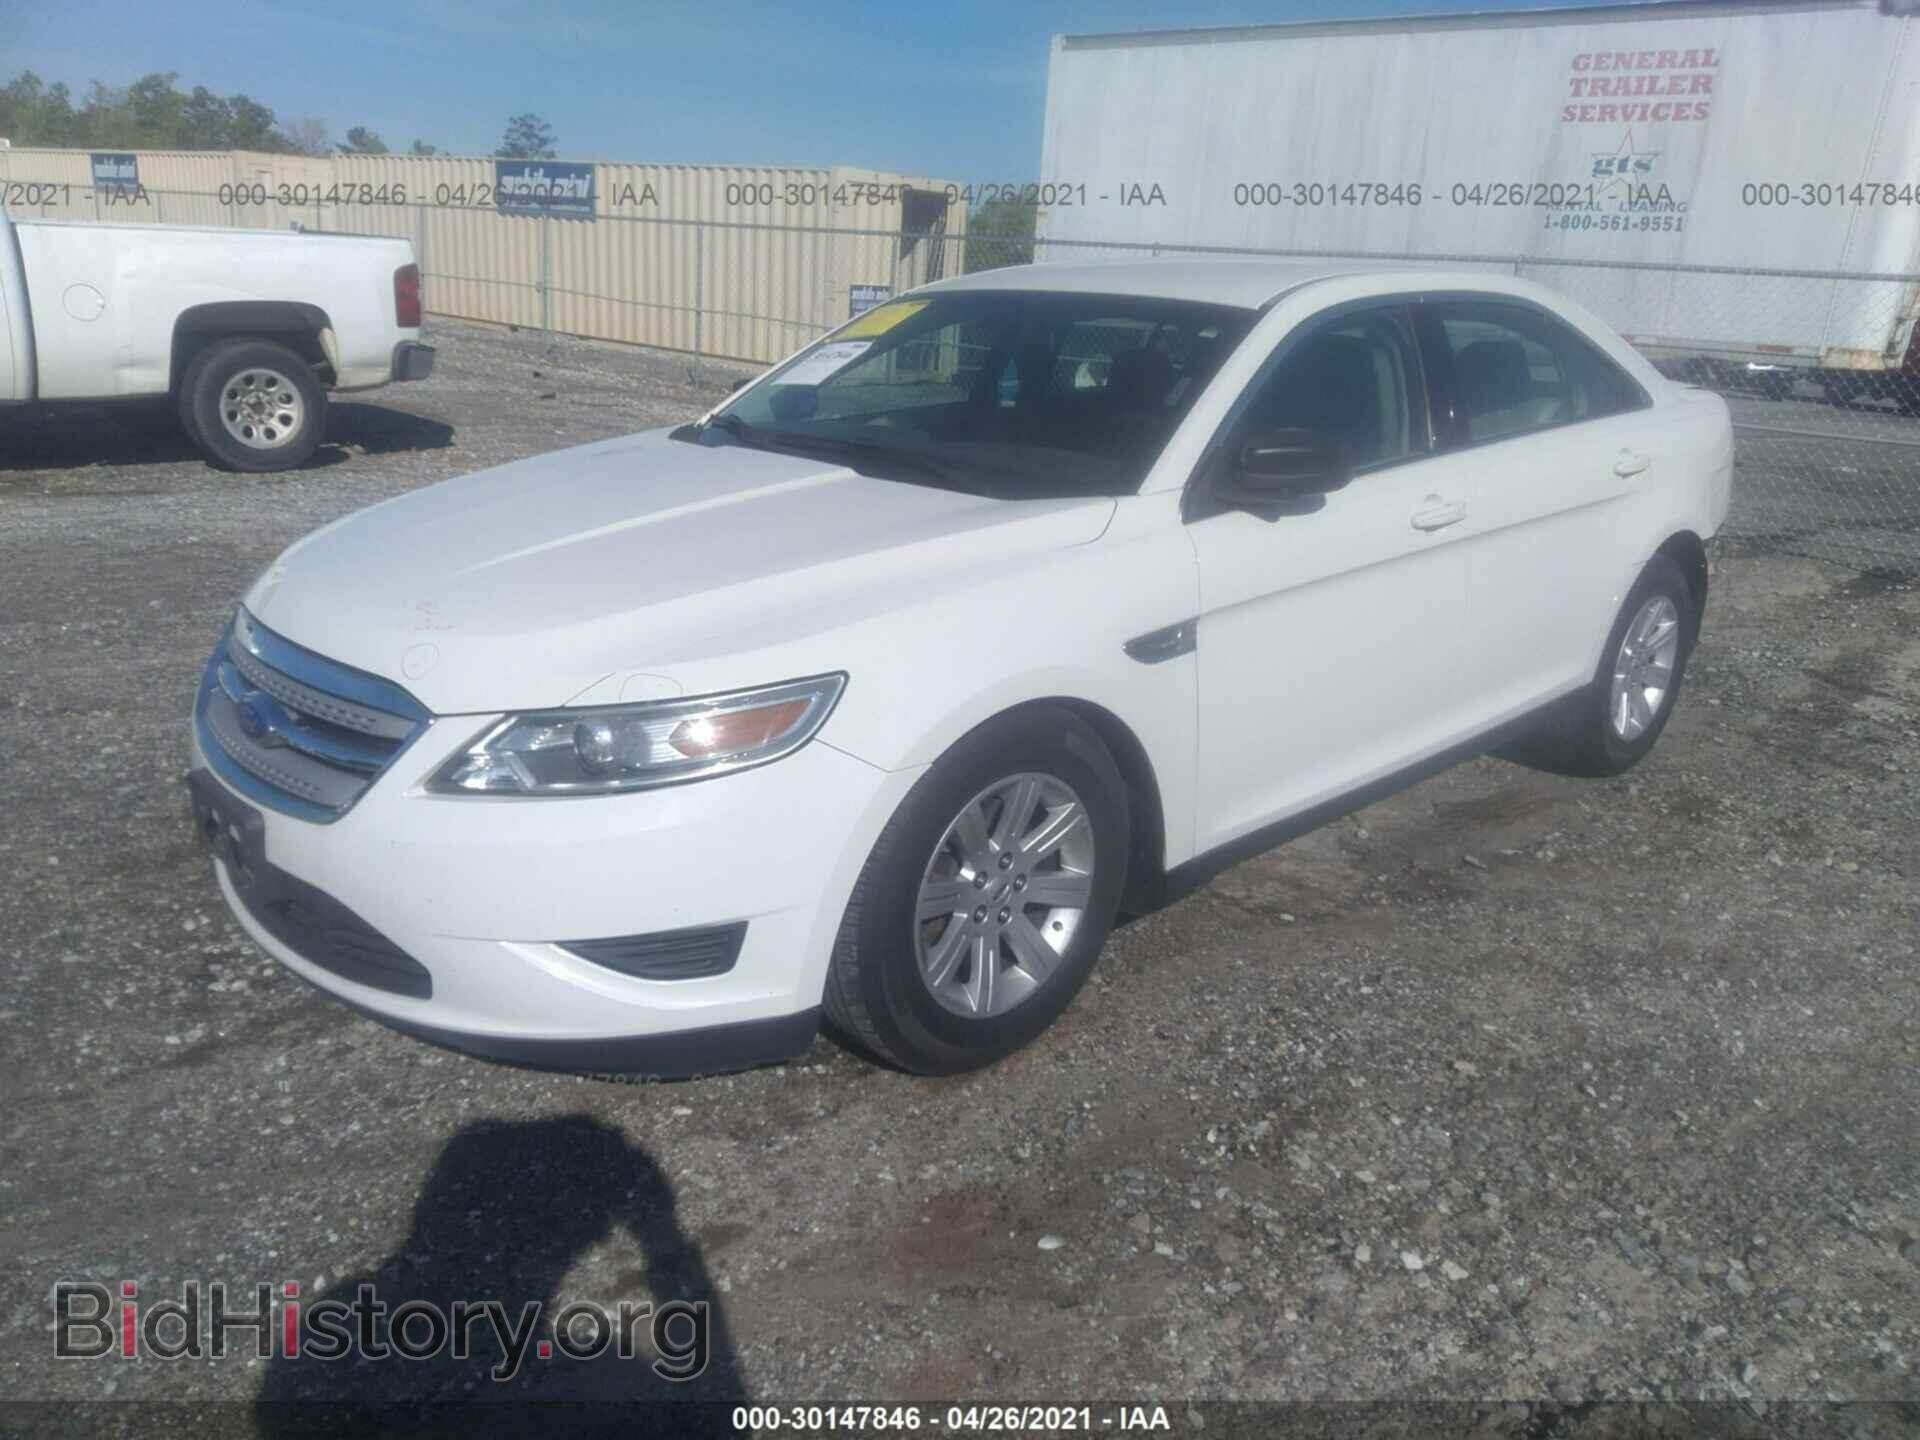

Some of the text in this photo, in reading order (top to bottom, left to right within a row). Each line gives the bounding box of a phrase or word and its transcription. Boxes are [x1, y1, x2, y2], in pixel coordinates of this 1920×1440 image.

[1571, 48, 1720, 72] GENERAL
[1569, 75, 1713, 97] TRAILER
[1561, 102, 1712, 123] SERVICES
[1592, 156, 1652, 178] gts
[1544, 214, 1684, 233] 1-800-561-9551
